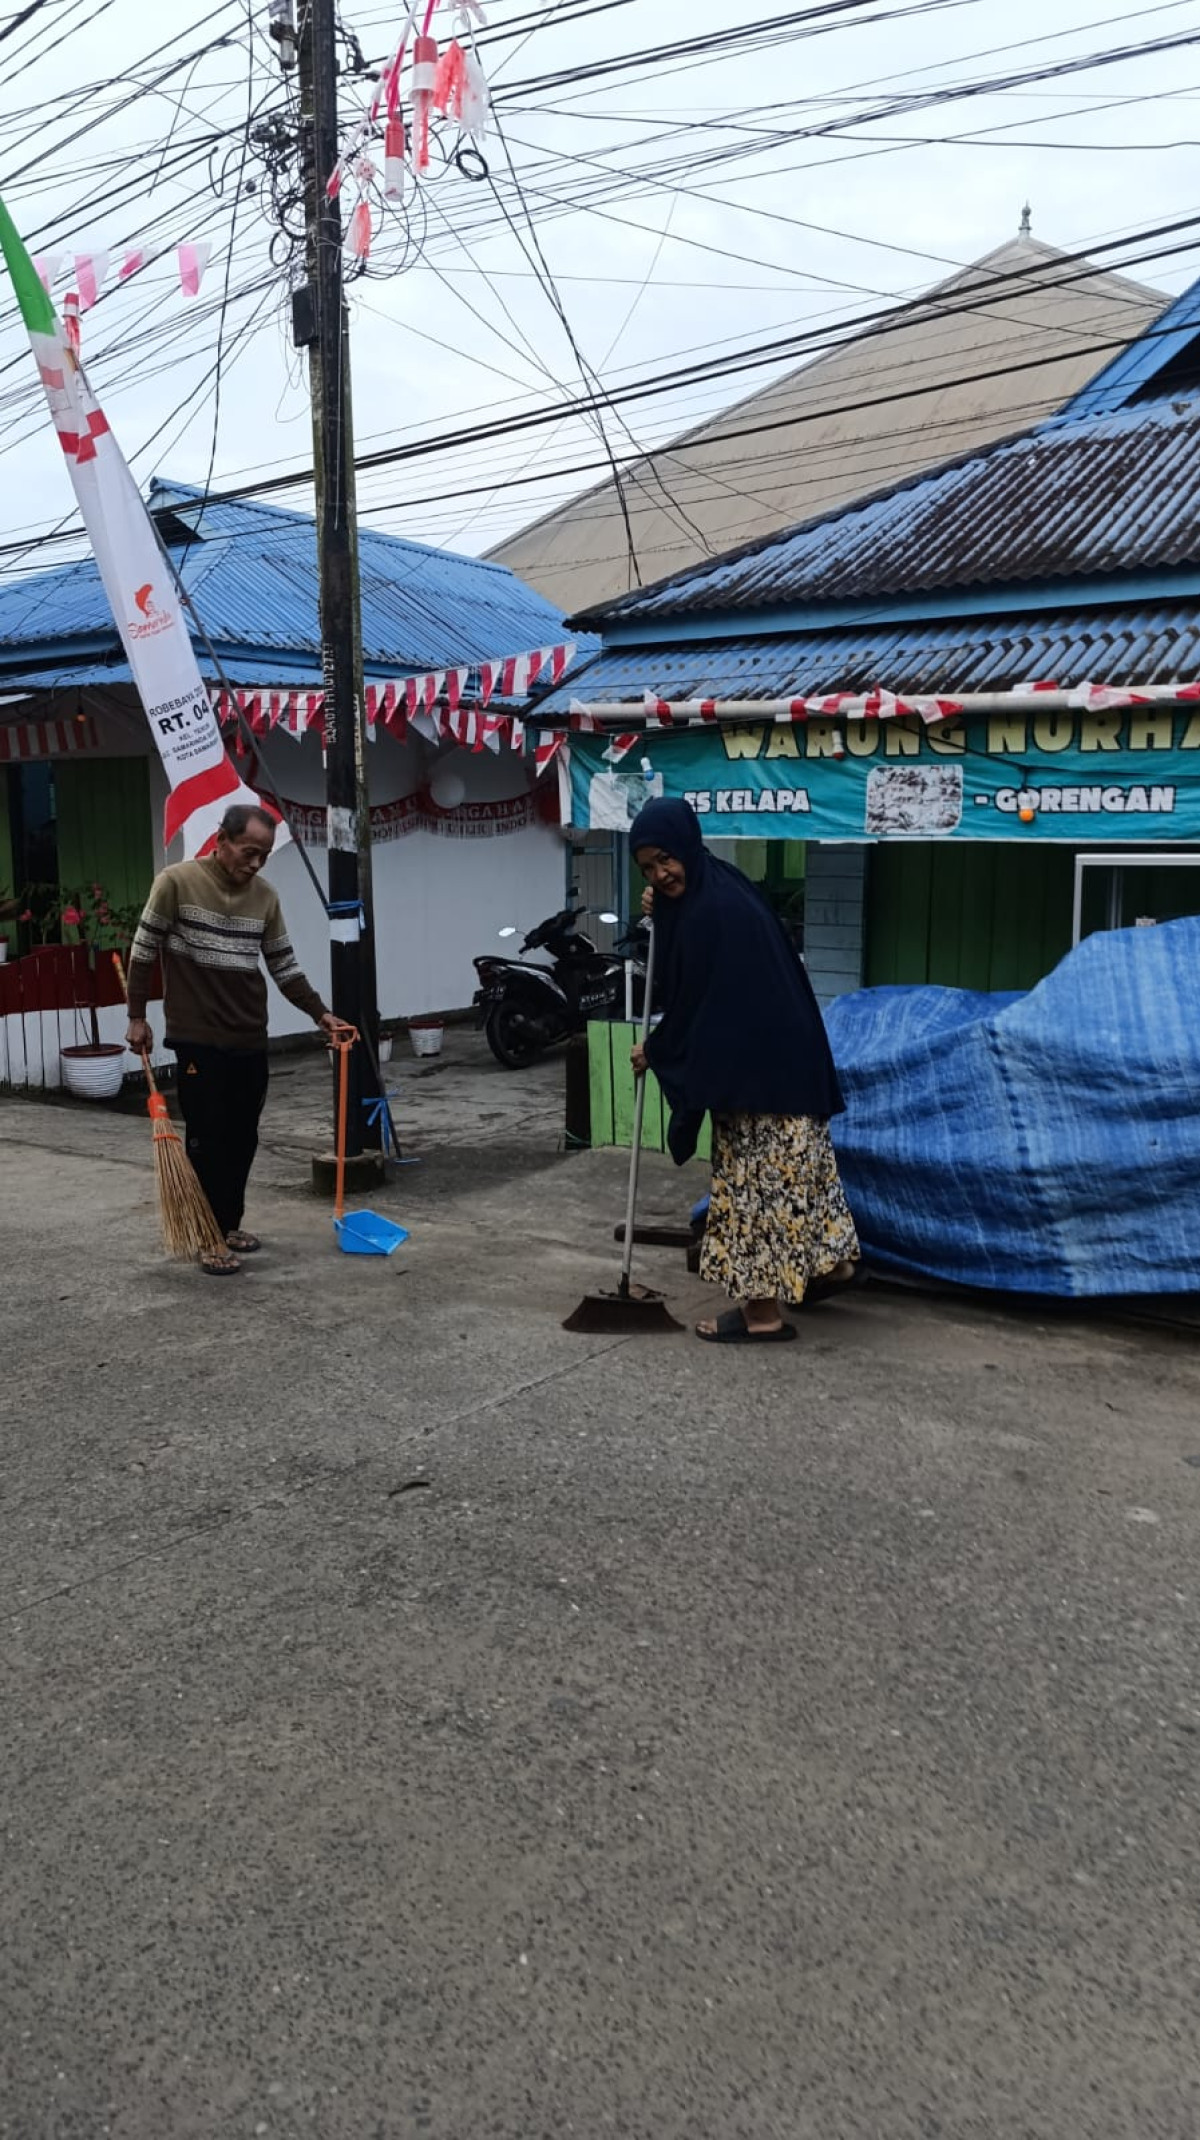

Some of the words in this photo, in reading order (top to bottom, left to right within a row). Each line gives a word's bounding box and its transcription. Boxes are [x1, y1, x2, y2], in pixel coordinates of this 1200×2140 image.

[158, 712, 190, 735] RT.
[193, 699, 209, 720] 04
[720, 714, 966, 760] WARUNG
[716, 789, 811, 813] KELAPA
[995, 786, 1175, 812] GORENGAN
